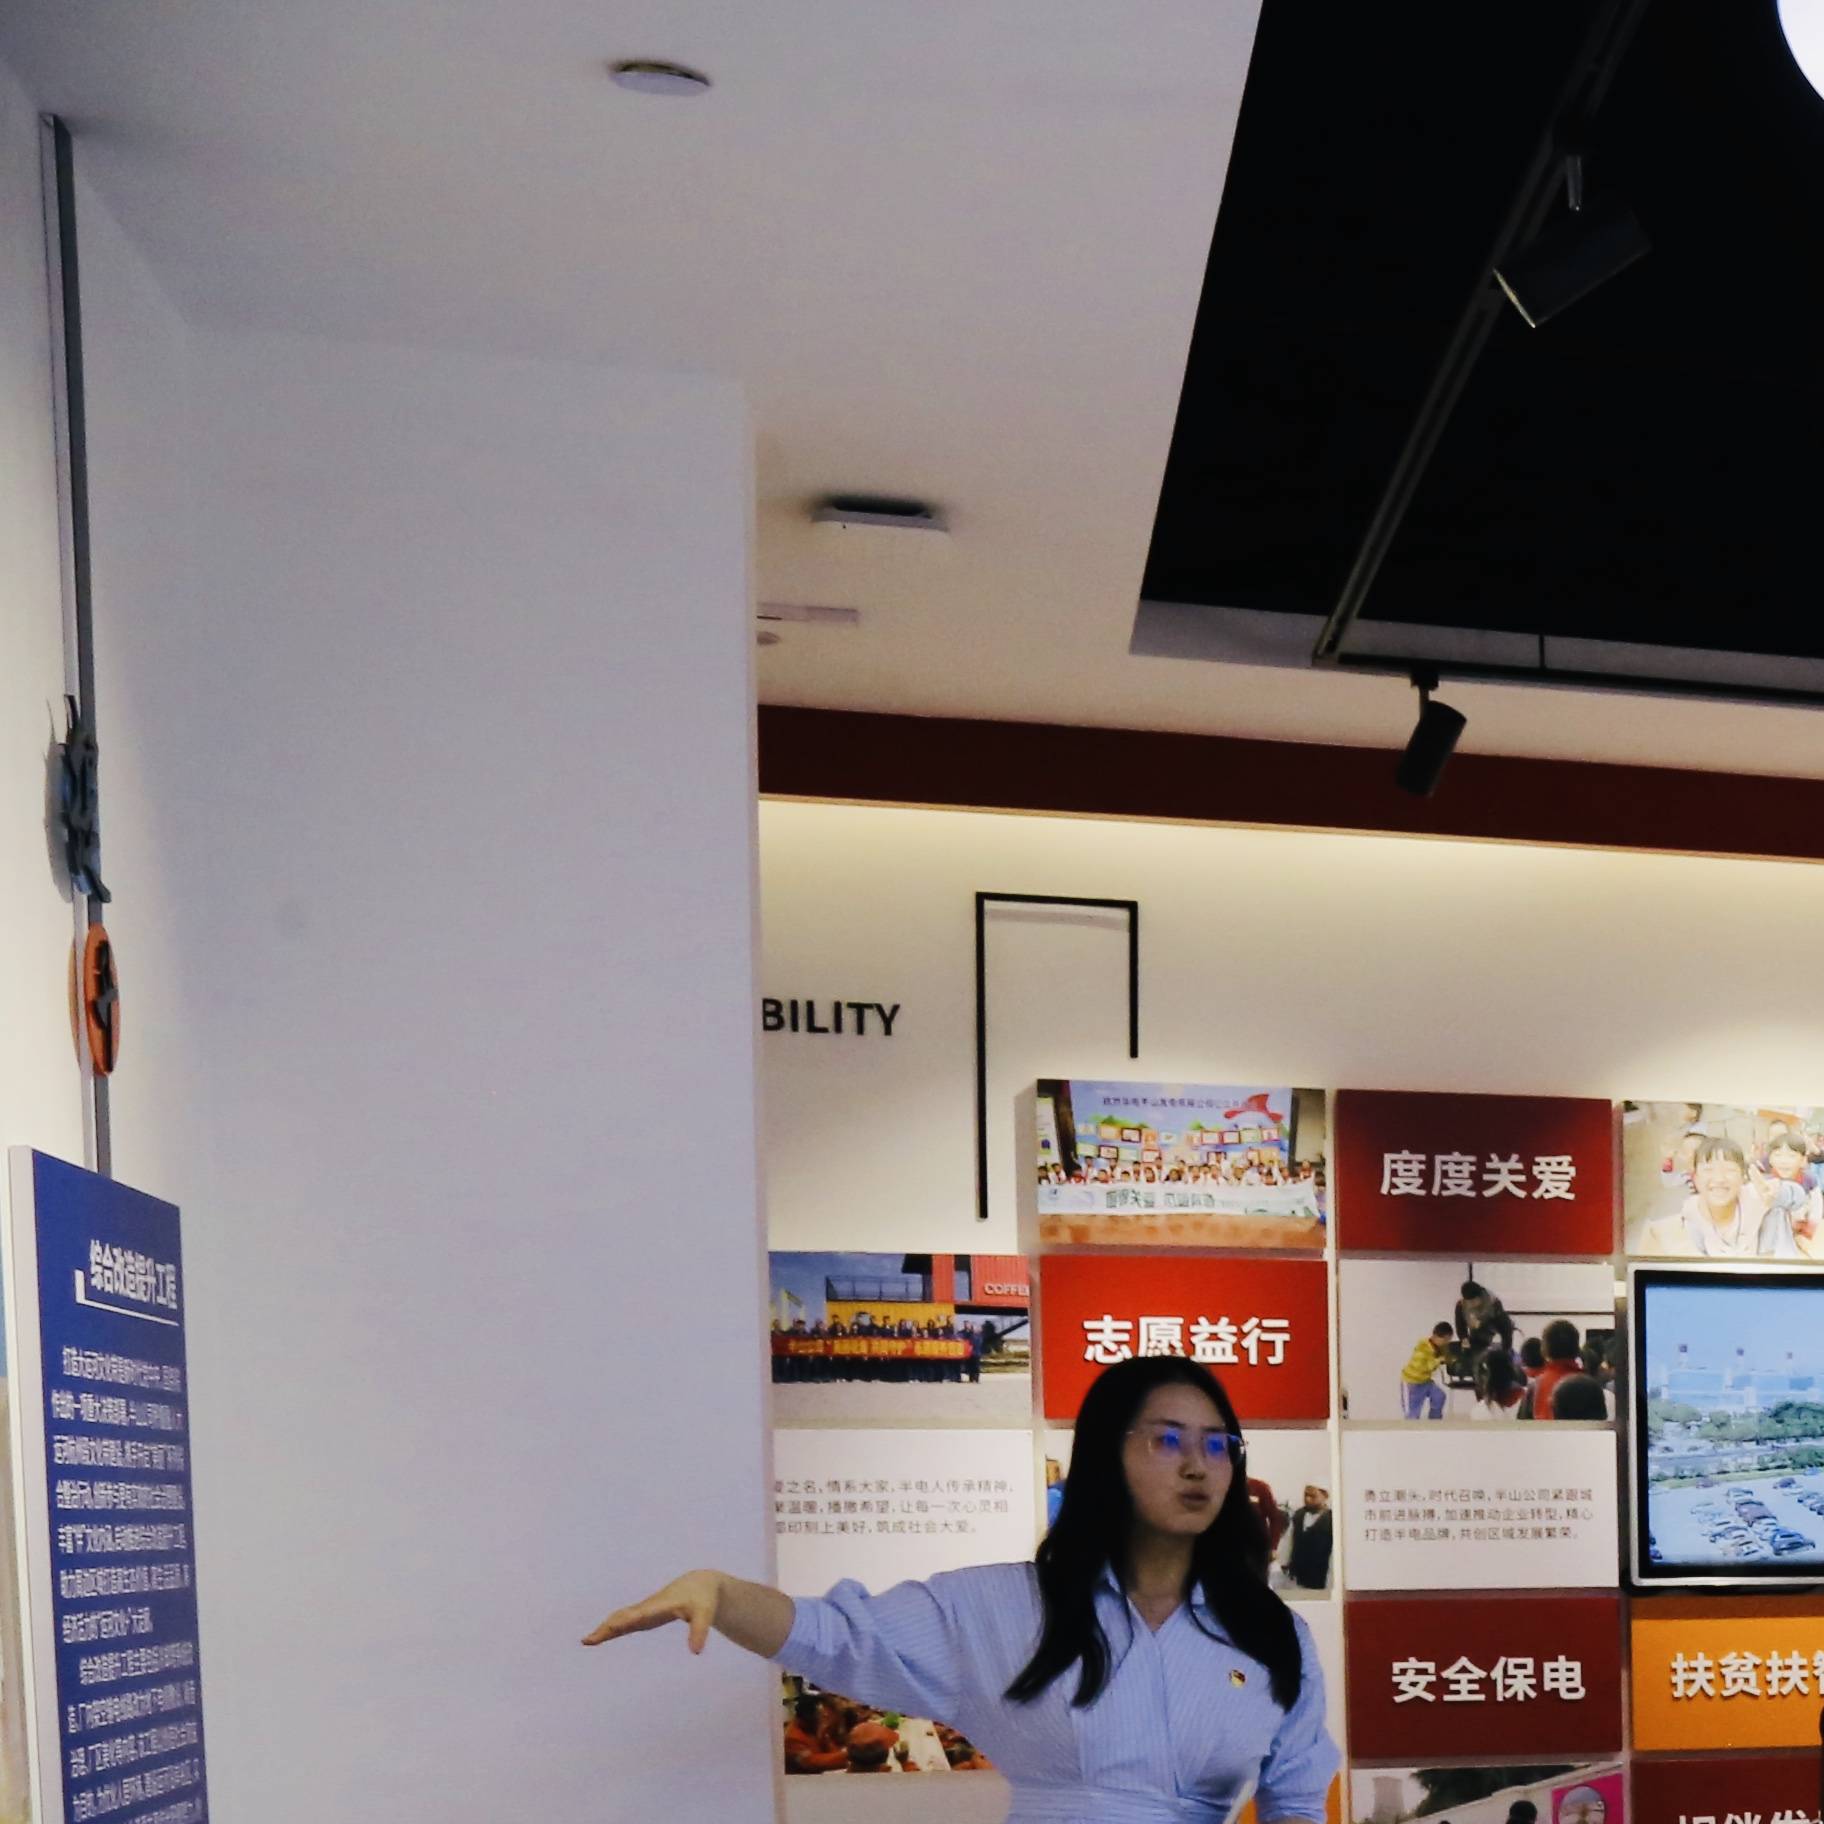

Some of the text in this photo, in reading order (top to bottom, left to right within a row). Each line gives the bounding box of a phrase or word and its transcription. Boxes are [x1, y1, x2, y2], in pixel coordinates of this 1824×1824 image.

[762, 998, 900, 1036] BILITY
[1380, 1150, 1578, 1202] 度度关爱
[89, 1238, 177, 1310] 综合改造提升工程
[1083, 1314, 1291, 1368] 志愿益行
[1392, 1654, 1586, 1703] 安全保电
